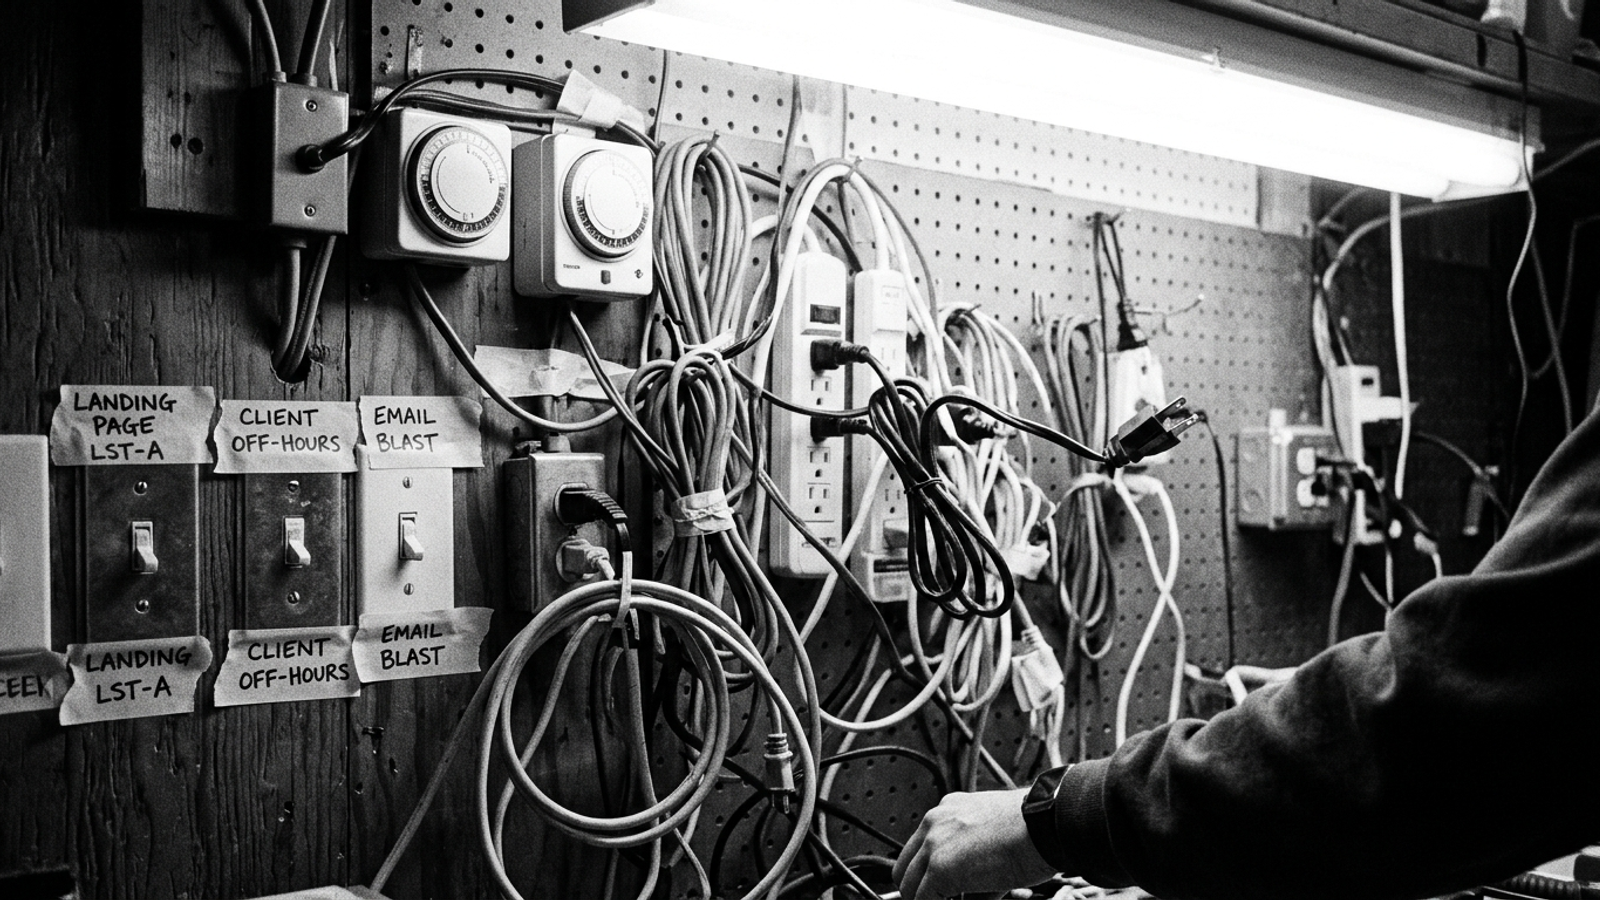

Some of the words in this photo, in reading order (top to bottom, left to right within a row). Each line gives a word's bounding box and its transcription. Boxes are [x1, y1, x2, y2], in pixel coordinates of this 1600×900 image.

[74, 392, 177, 413] LANDING
[92, 415, 156, 437] PAGE
[240, 407, 319, 427] CLIENT
[374, 405, 437, 426] EMAIL
[90, 440, 164, 461] LST-A
[231, 434, 341, 453] OFF-HOURS
[376, 432, 439, 453] BLAST
[381, 623, 443, 644] EMAIL
[85, 646, 193, 673] LANDING
[247, 637, 331, 661] CLIENT
[380, 645, 446, 670] BLAST
[239, 663, 350, 690] OFF-HOURS
[96, 675, 172, 704] LST-A
